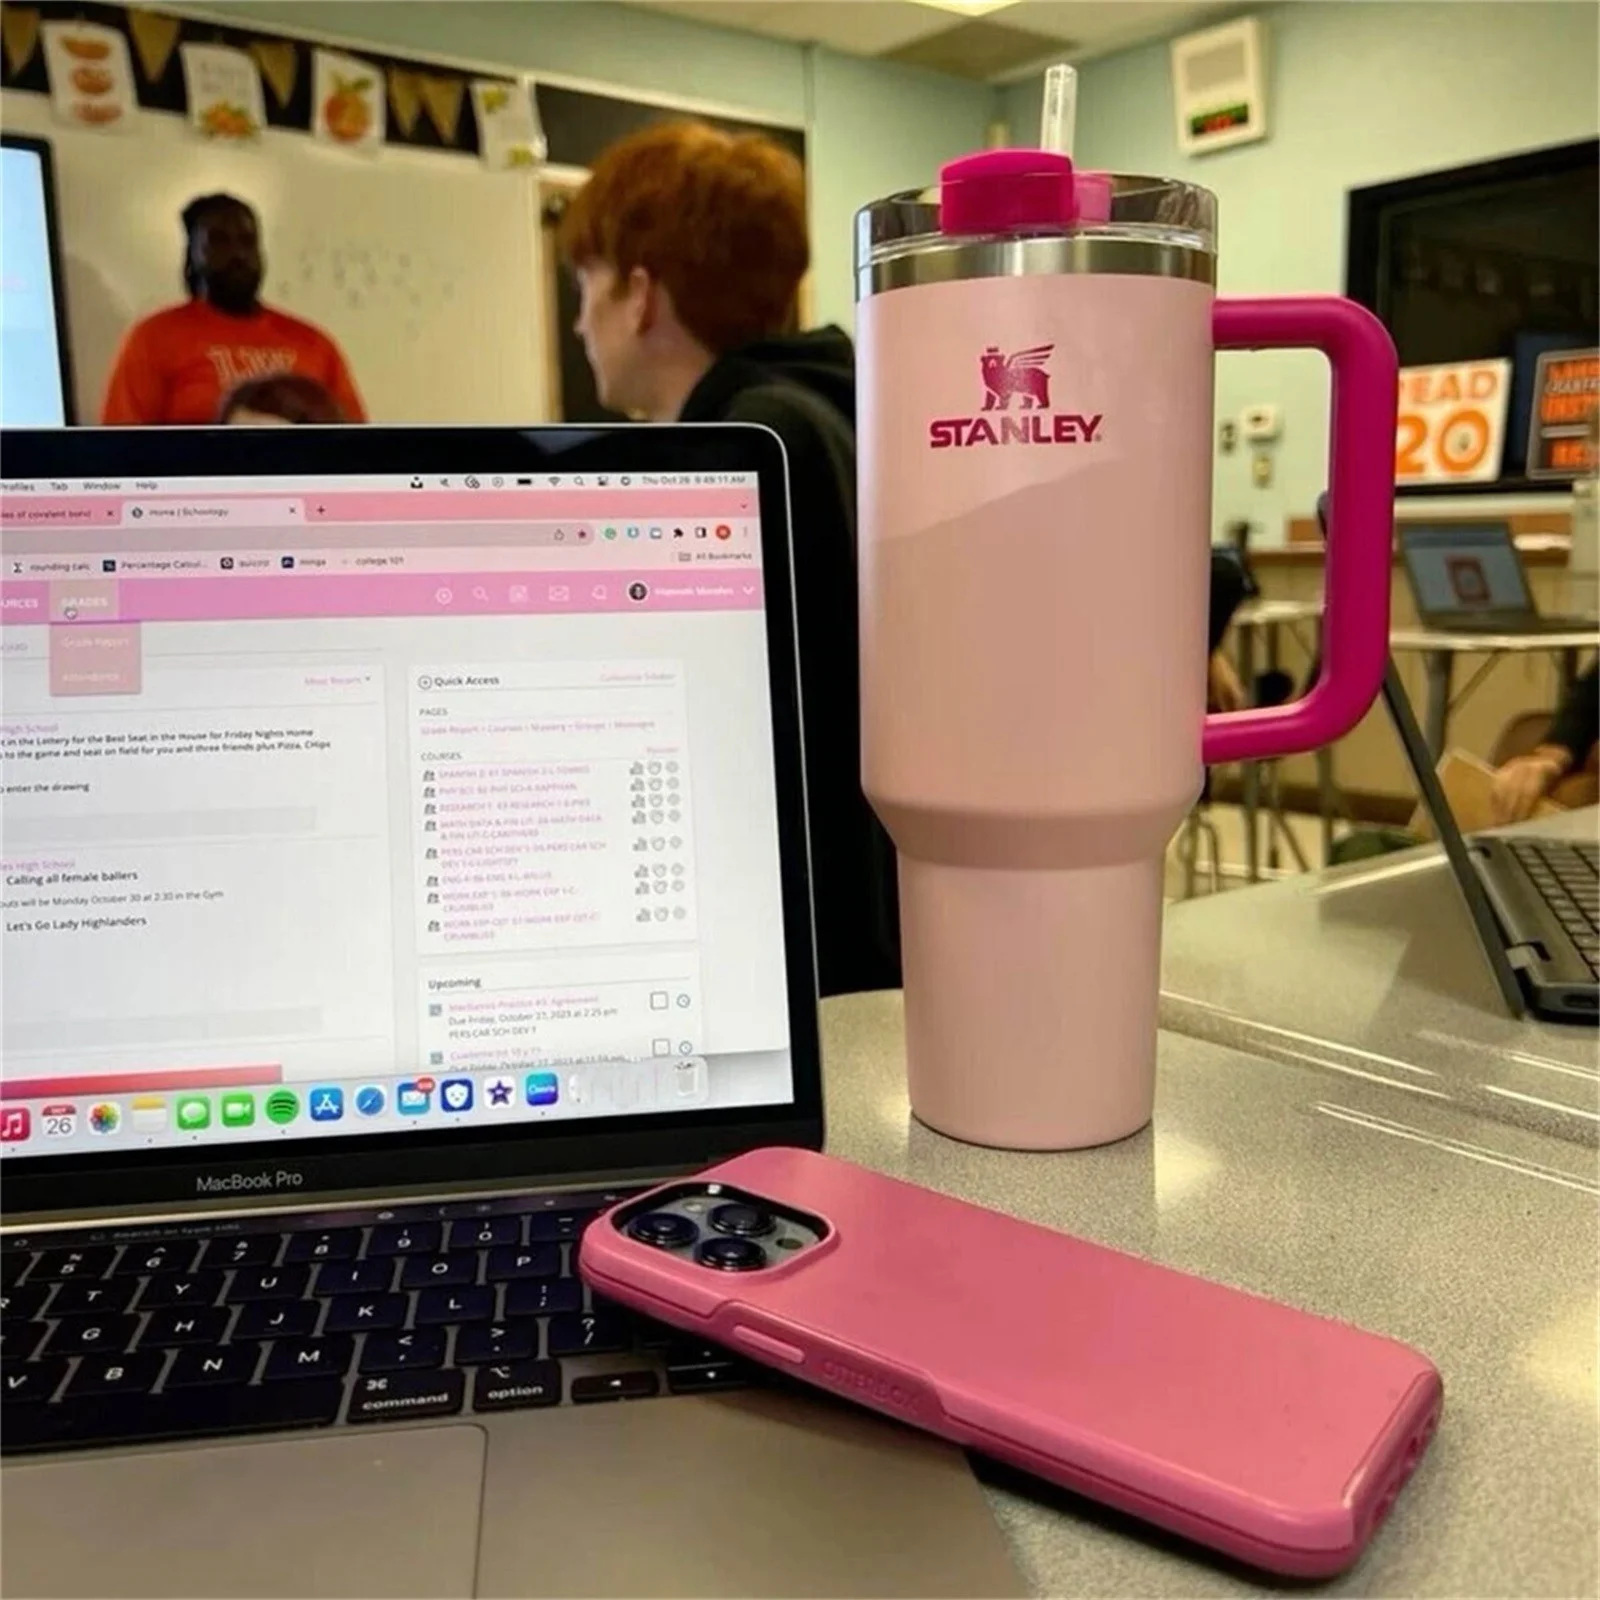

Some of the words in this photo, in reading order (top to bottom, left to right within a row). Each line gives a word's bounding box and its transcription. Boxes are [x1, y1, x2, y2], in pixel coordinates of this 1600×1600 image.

[930, 413, 1103, 448] STANLEY
[51, 482, 68, 491] Tab
[83, 481, 121, 491] Window
[136, 481, 157, 491] Help
[661, 475, 677, 484] Oct
[434, 675, 463, 687] Quick
[465, 674, 500, 686] Access
[419, 707, 448, 717] PAGES
[19, 738, 34, 746] the
[37, 737, 69, 747] Lottery
[72, 735, 85, 744] for
[88, 735, 103, 744] the
[105, 734, 126, 743] Best
[128, 733, 147, 743] Seat
[150, 734, 159, 742] in
[161, 732, 175, 741] the
[178, 731, 207, 741] House
[209, 731, 222, 740] for
[224, 730, 252, 740] Friday
[255, 728, 285, 740] Nights
[286, 728, 314, 738] Home
[17, 750, 33, 759] the
[35, 751, 61, 761] game
[63, 748, 81, 758] and
[83, 749, 103, 757] seat
[105, 748, 117, 756] on
[119, 747, 139, 756] field
[141, 746, 154, 755] for
[156, 747, 174, 756] you
[176, 744, 193, 754] and
[195, 743, 220, 753] three
[222, 742, 254, 752] friends
[256, 741, 276, 752] plus
[420, 751, 463, 762] COURSES
[7, 785, 32, 793] enter
[34, 783, 49, 792] the
[52, 783, 89, 793] drawing
[6, 874, 44, 886] Calling
[46, 873, 60, 884] all
[62, 872, 99, 883] female
[101, 871, 138, 882] ballers
[21, 897, 36, 908] will
[38, 897, 50, 907] be
[52, 896, 89, 907] Monday
[91, 894, 127, 905] October
[130, 893, 142, 903] 30
[175, 891, 184, 900] in
[185, 889, 201, 900] the
[203, 889, 225, 901] Gym
[6, 920, 33, 933] Let's
[35, 919, 51, 931] Go
[53, 917, 80, 931] Lady
[81, 915, 147, 930] Highlanders
[428, 976, 482, 990] Upcoming
[449, 1016, 466, 1026] Due
[498, 1012, 534, 1023] October
[551, 1009, 572, 1020] 2023
[449, 1029, 472, 1040] PERS
[472, 1028, 490, 1039] CAR
[493, 1026, 510, 1037] SCH
[512, 1025, 530, 1036] DEV
[47, 1117, 72, 1135] 26
[196, 1171, 272, 1192] MacBook
[275, 1170, 303, 1187] Pro
[88, 1290, 103, 1301] T
[175, 1283, 191, 1295] Y
[260, 1276, 278, 1289] U
[431, 1262, 449, 1275] O
[516, 1255, 532, 1267] P
[82, 1327, 101, 1341] G
[174, 1319, 195, 1333] H
[269, 1312, 285, 1325] J
[357, 1304, 375, 1318] K
[448, 1298, 463, 1310] L
[8, 1374, 28, 1389] V
[104, 1366, 124, 1381] B
[203, 1357, 224, 1373] N
[297, 1350, 321, 1364] M
[362, 1392, 449, 1411] command
[487, 1383, 545, 1401] option
